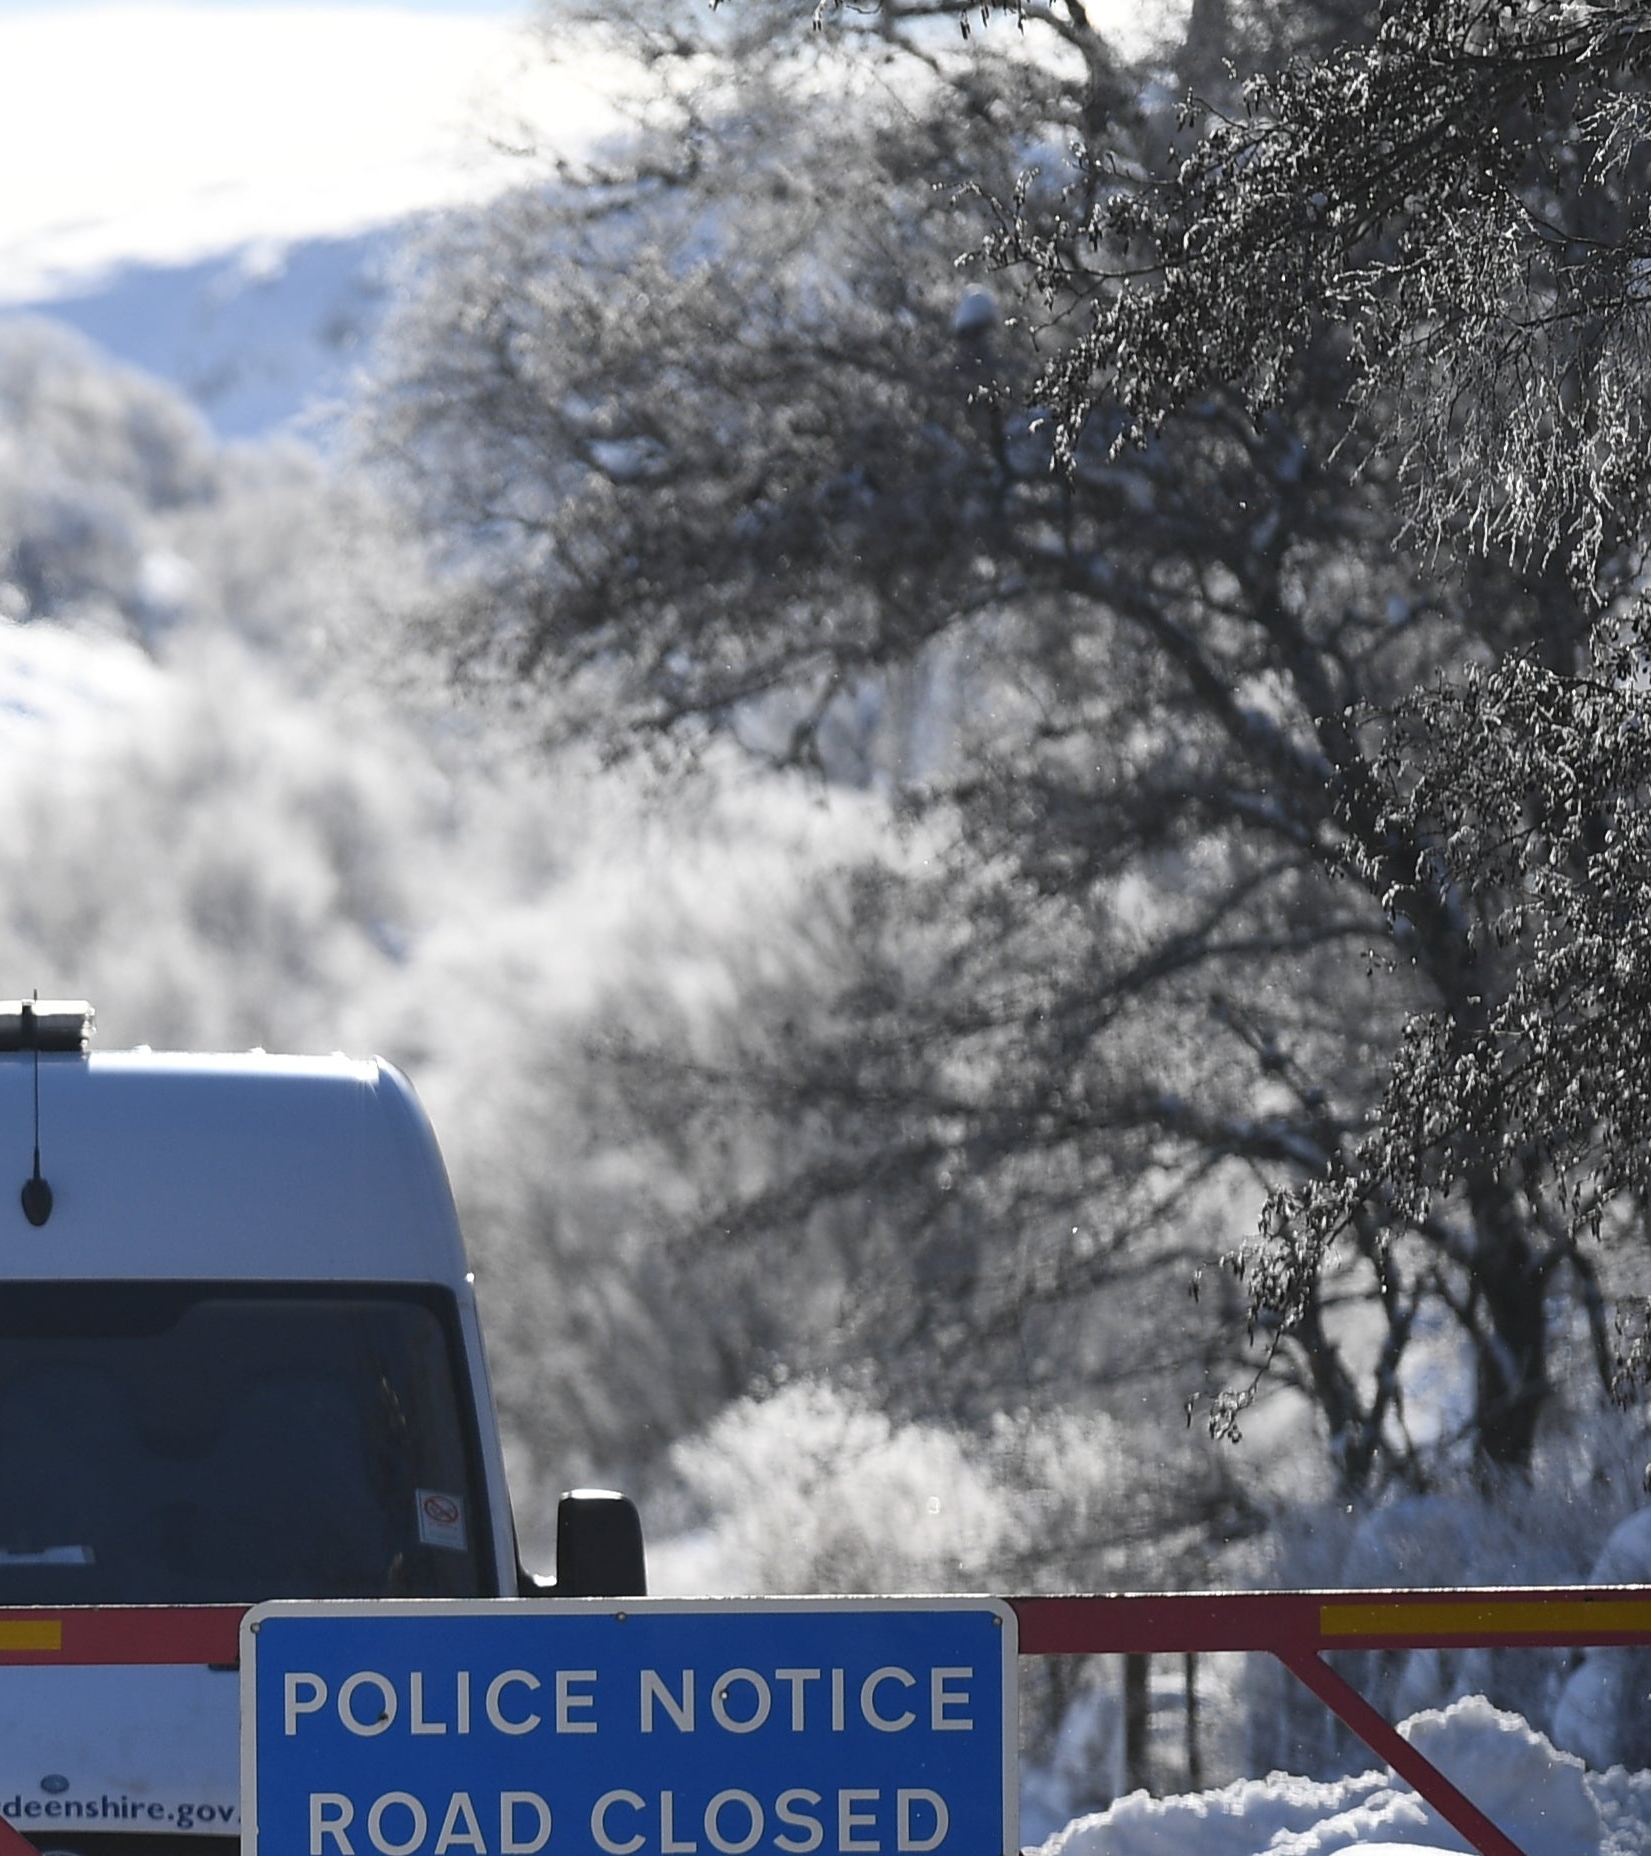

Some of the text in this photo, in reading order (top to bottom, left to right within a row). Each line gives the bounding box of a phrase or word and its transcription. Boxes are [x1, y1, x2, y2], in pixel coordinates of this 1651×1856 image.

[284, 1667, 974, 1736] POLICE NOTICE
[310, 1789, 949, 1856] ROAD CLOSED
